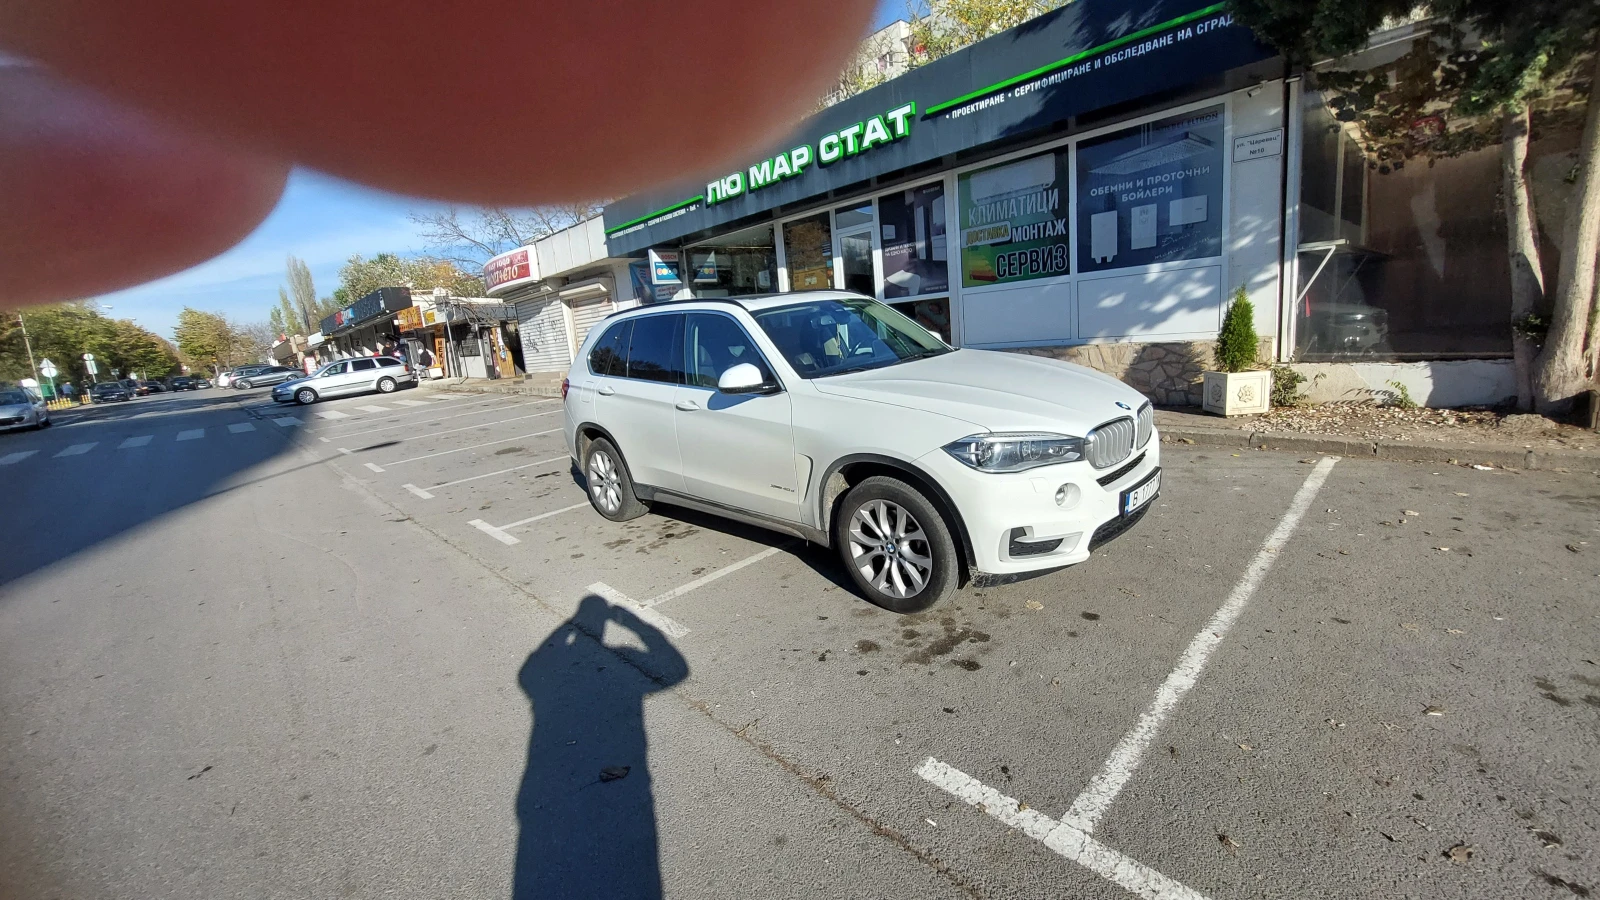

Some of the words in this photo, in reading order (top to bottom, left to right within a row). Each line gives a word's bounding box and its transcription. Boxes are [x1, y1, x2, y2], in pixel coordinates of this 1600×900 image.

[952, 93, 1005, 119] ПРОЕКТИРАНЕ
[1014, 62, 1092, 98] СЕРТИФИЦИРАНЕ
[1094, 58, 1101, 70] И
[1104, 34, 1174, 66] ОБСЛЕДВАНЕ
[1177, 27, 1193, 42] НА
[706, 172, 745, 204] ЛЮ
[749, 145, 813, 190] МАР
[819, 101, 916, 164] СТАТ
[1090, 181, 1133, 197] ОБЕМНИ
[1136, 178, 1144, 188] И
[1147, 165, 1210, 186] ПРОТОЧНИ
[1121, 184, 1173, 202] БОЙЛЕРИ
[968, 188, 1059, 227] КЛИМАТИЦИ
[966, 223, 1009, 246] ДОСТАВКА
[1011, 217, 1067, 243] МОНТАЖ
[996, 244, 1068, 279] СЕРВИЗ
